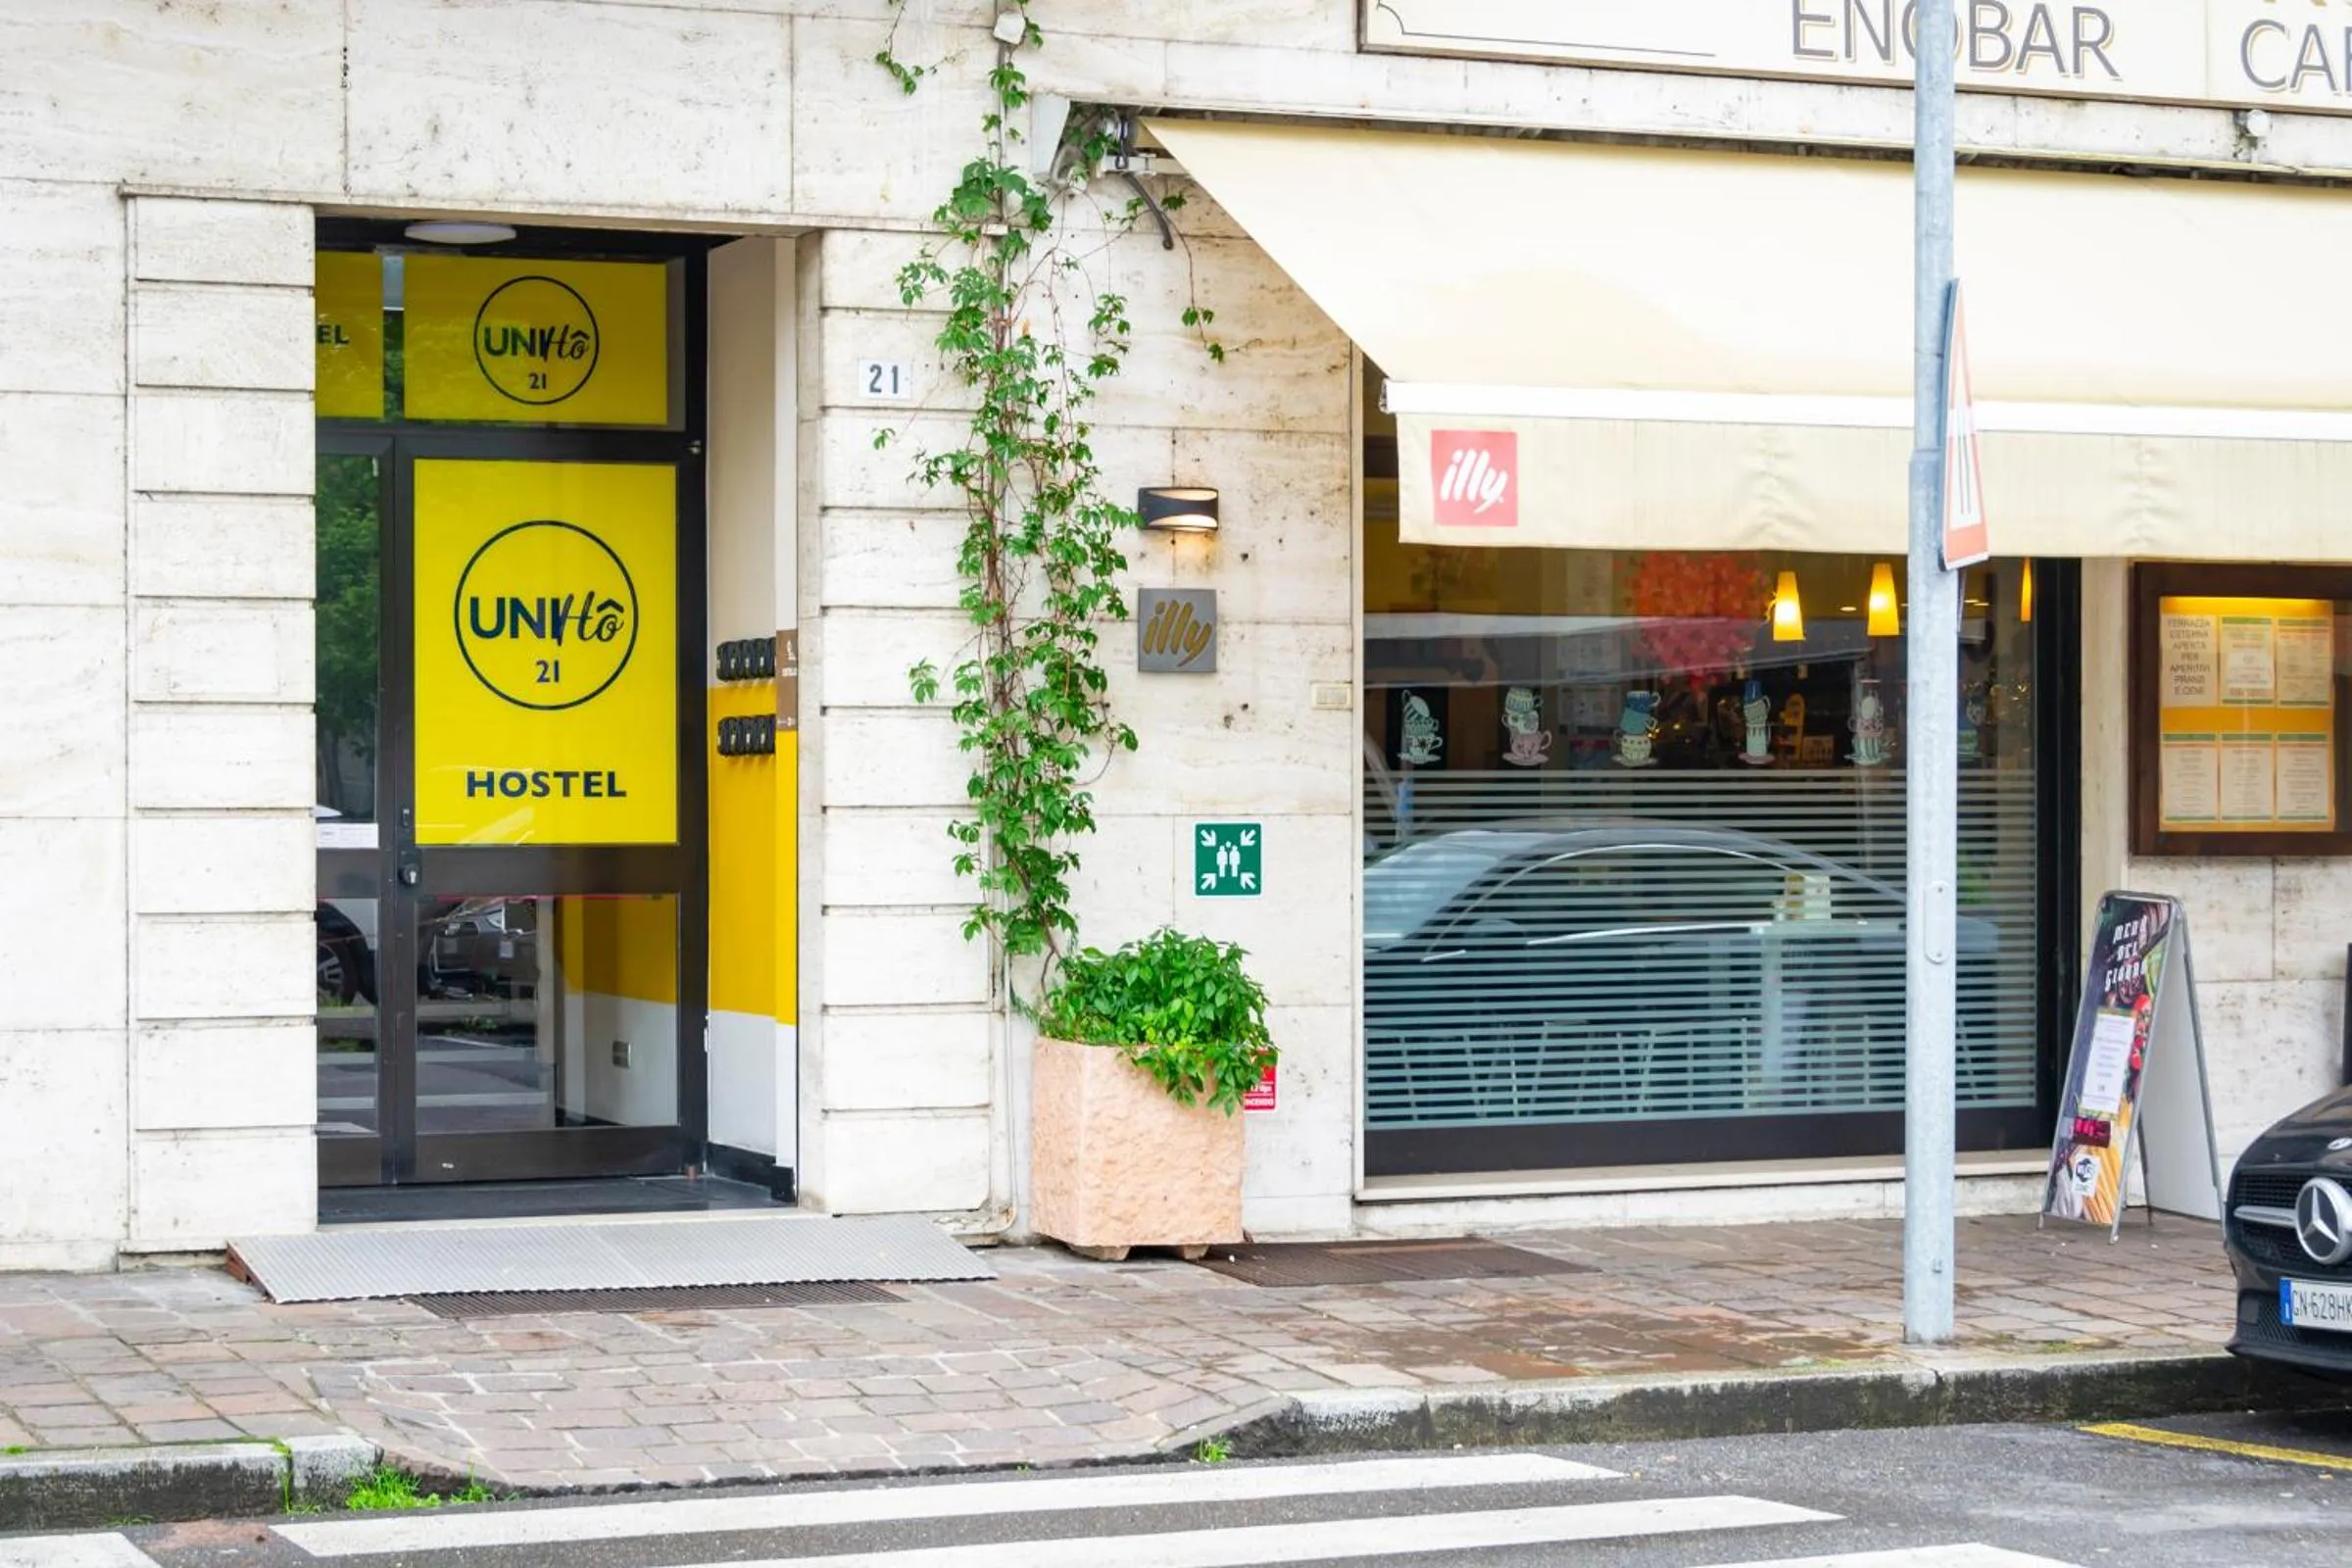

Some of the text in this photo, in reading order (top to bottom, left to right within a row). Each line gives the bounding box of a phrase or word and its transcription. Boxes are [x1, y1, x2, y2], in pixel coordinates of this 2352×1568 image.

[2240, 19, 2352, 96] CA
[529, 372, 547, 389] 21
[869, 364, 898, 394] 21
[1440, 449, 1508, 514] illy
[1143, 600, 1212, 667] illy
[536, 661, 559, 683] 21
[466, 771, 627, 797] HOSTEL
